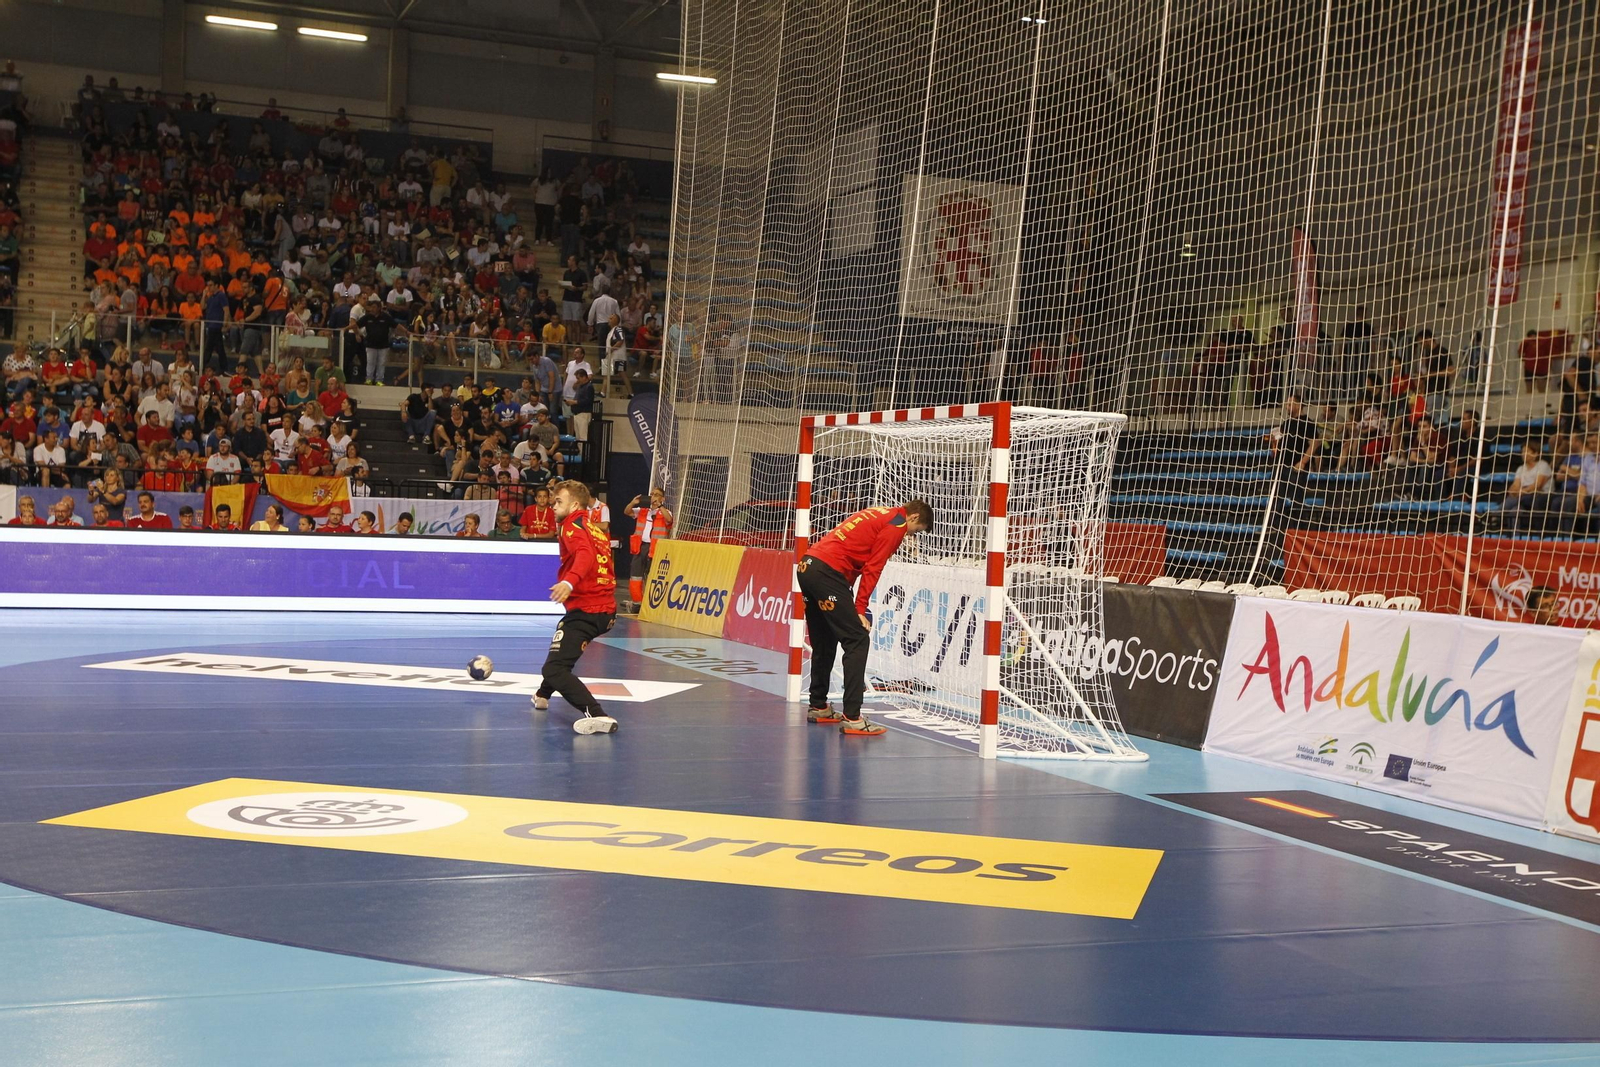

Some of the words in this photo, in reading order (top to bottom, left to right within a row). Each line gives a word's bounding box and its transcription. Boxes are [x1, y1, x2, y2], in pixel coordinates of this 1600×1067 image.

[667, 575, 729, 617] Correos
[1558, 596, 1600, 622] 202
[865, 584, 987, 673] acyr
[132, 657, 520, 688] helvetia
[642, 646, 778, 676] Gerflor
[1236, 610, 1538, 760] Andalucía
[502, 820, 1067, 882] Correos
[1327, 819, 1600, 896] SPAGNO
[1385, 846, 1470, 868] DESDE
